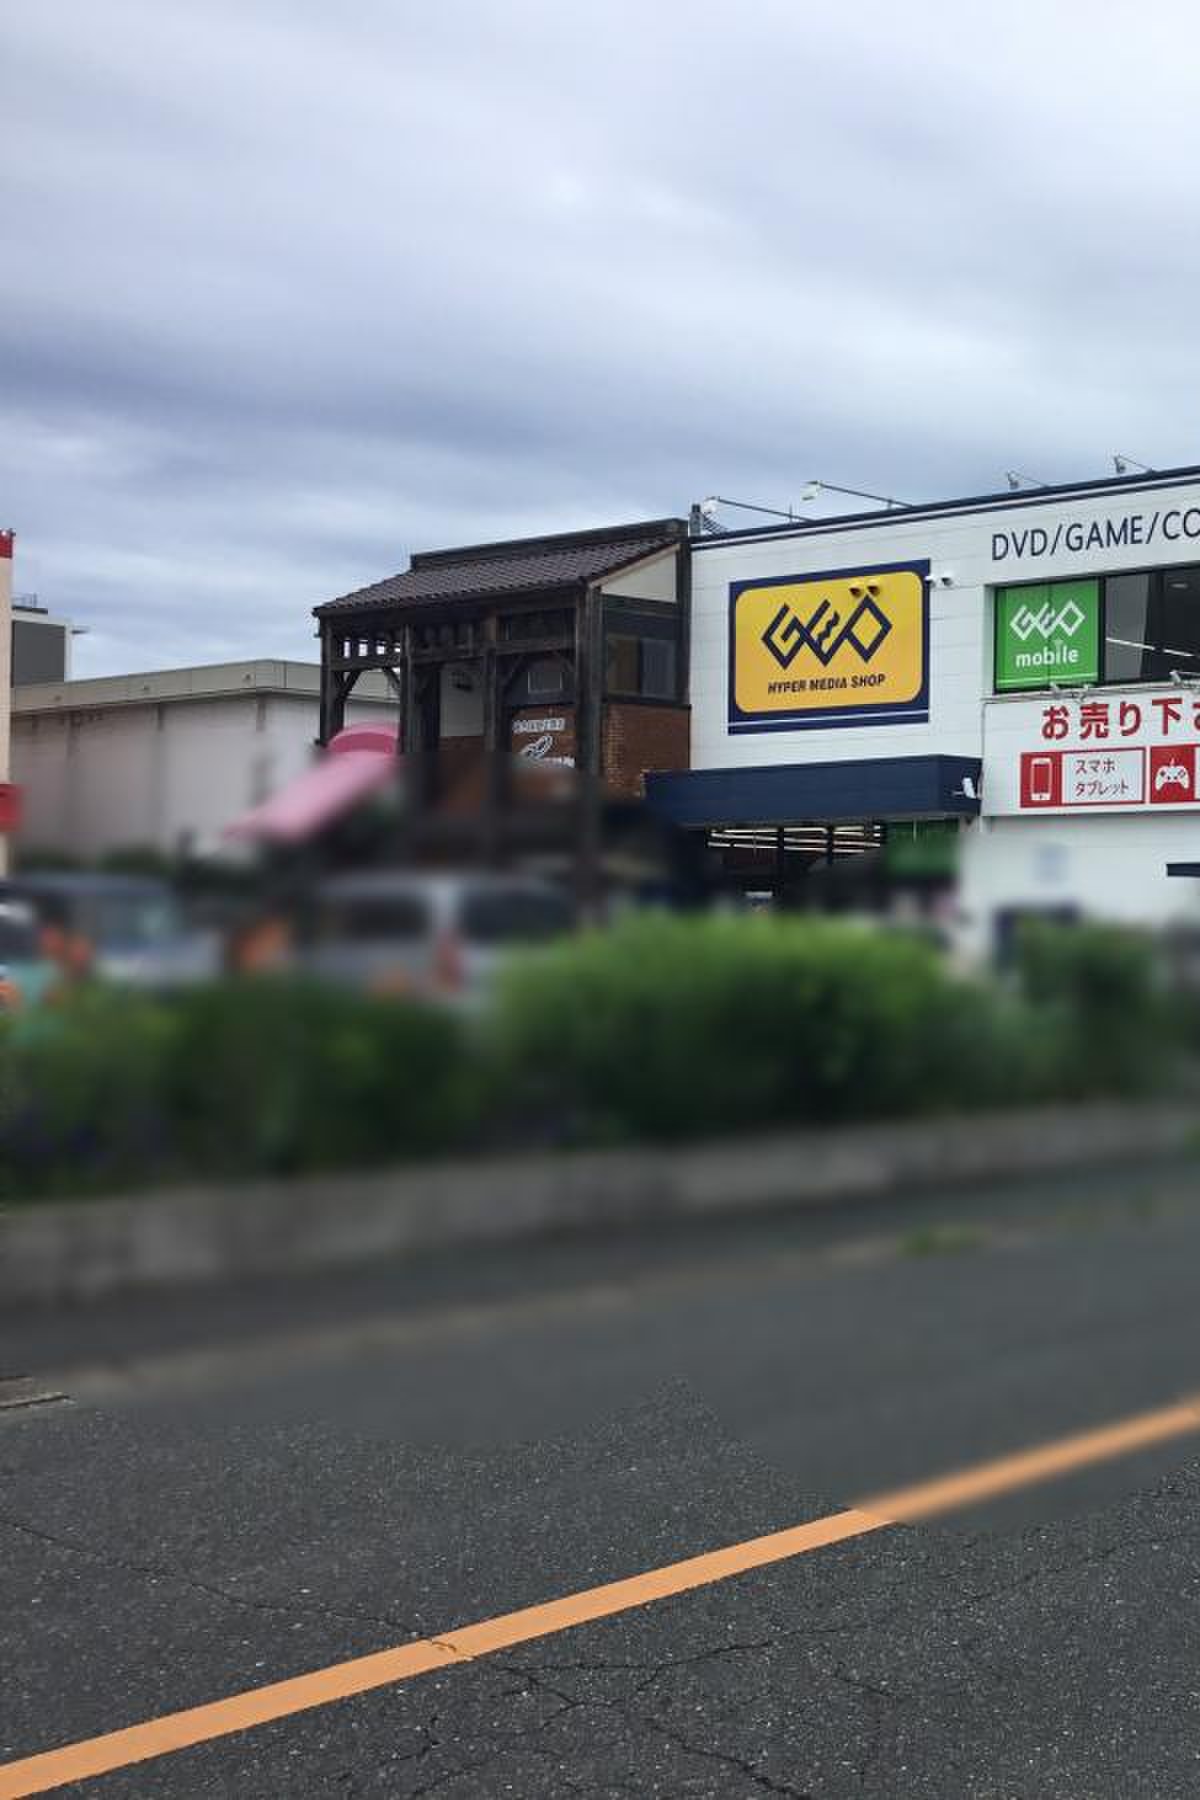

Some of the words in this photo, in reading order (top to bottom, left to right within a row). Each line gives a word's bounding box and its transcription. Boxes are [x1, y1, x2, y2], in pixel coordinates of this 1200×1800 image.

[1010, 600, 1085, 641] GEO
[761, 595, 893, 670] GEO
[1015, 642, 1079, 668] mobile
[768, 680, 806, 694] HYPER
[809, 677, 848, 690] MEDIA
[851, 673, 886, 688] SHOP
[1075, 759, 1116, 775] スマホ
[1075, 779, 1129, 797] タブレット
